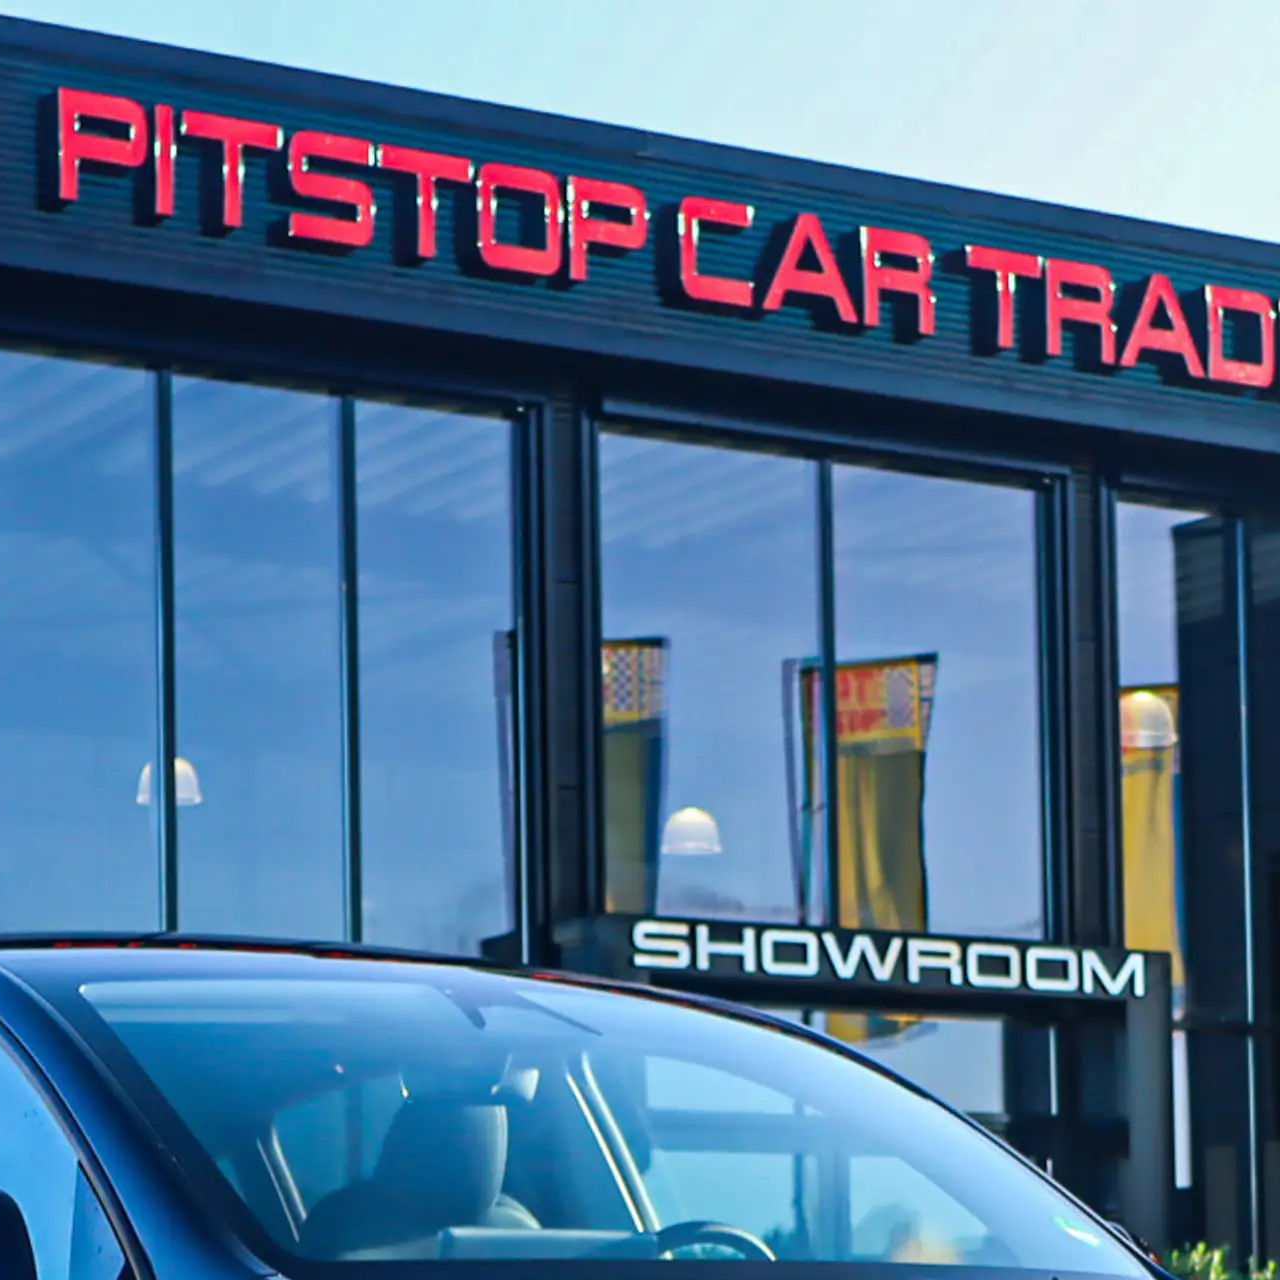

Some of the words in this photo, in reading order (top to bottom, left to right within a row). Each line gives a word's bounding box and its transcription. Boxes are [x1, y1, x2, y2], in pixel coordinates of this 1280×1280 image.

[55, 86, 649, 281] PITSTOP
[677, 196, 936, 336] CAR
[632, 920, 1145, 998] SHOWROOM
